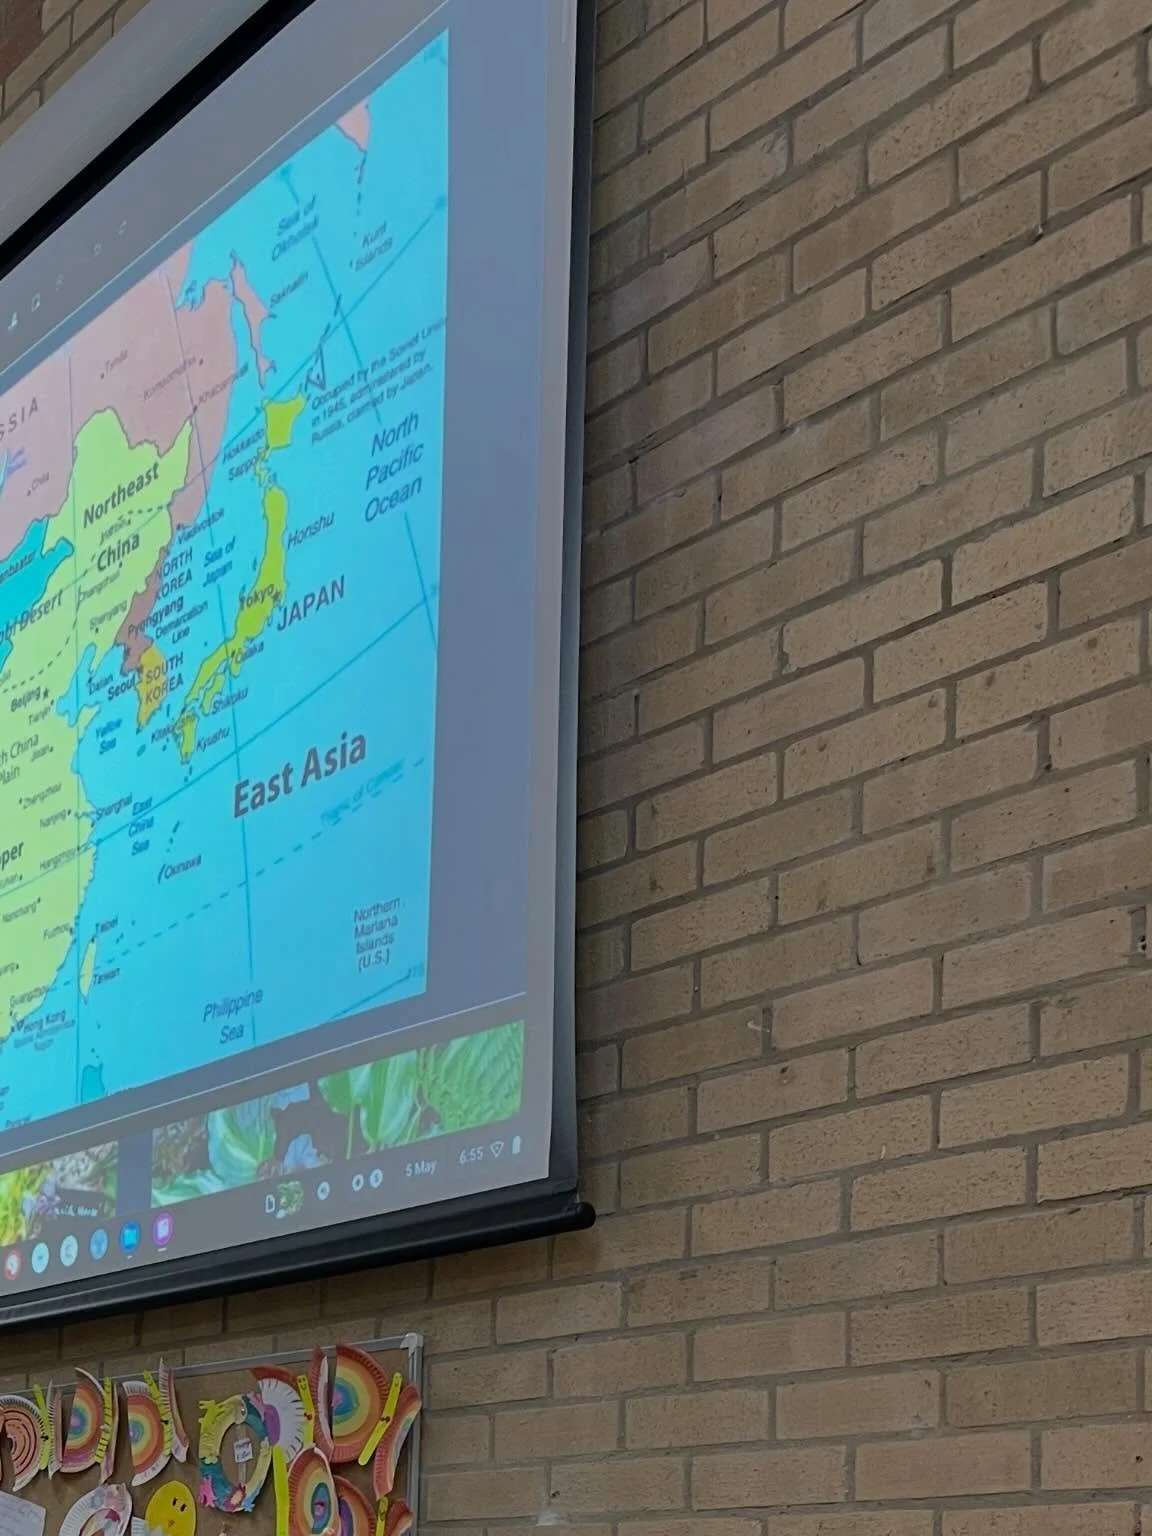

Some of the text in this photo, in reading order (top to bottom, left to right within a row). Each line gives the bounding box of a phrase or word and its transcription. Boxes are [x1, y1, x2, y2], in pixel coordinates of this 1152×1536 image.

[371, 411, 420, 457] North
[365, 443, 425, 491] Pacific
[83, 462, 160, 529] Northeast
[364, 477, 423, 523] Ocean
[287, 512, 335, 549] Honshu
[97, 533, 140, 572] China
[156, 547, 193, 580] NORTH
[156, 568, 193, 601] KOREA
[238, 583, 275, 611] Tokyo
[19, 589, 64, 632] Desert
[127, 596, 184, 638] Pyongyang
[276, 575, 346, 632] JAPAN
[145, 652, 184, 685] SOUTH
[10, 686, 41, 712] Beijing
[108, 674, 136, 701] Seoul
[145, 673, 184, 704] KOREA
[9, 734, 39, 760] China
[197, 727, 230, 752] Kyushu
[233, 762, 294, 818] East
[300, 730, 367, 788] Asia
[353, 897, 401, 924] Northern
[354, 916, 399, 940] Mariana
[355, 932, 395, 955] Islands
[358, 950, 391, 974] (U.S.)
[202, 989, 264, 1024] Philippine
[219, 1024, 245, 1045] Sea
[405, 1159, 437, 1177] 5 May
[459, 1146, 484, 1165] 6:55
